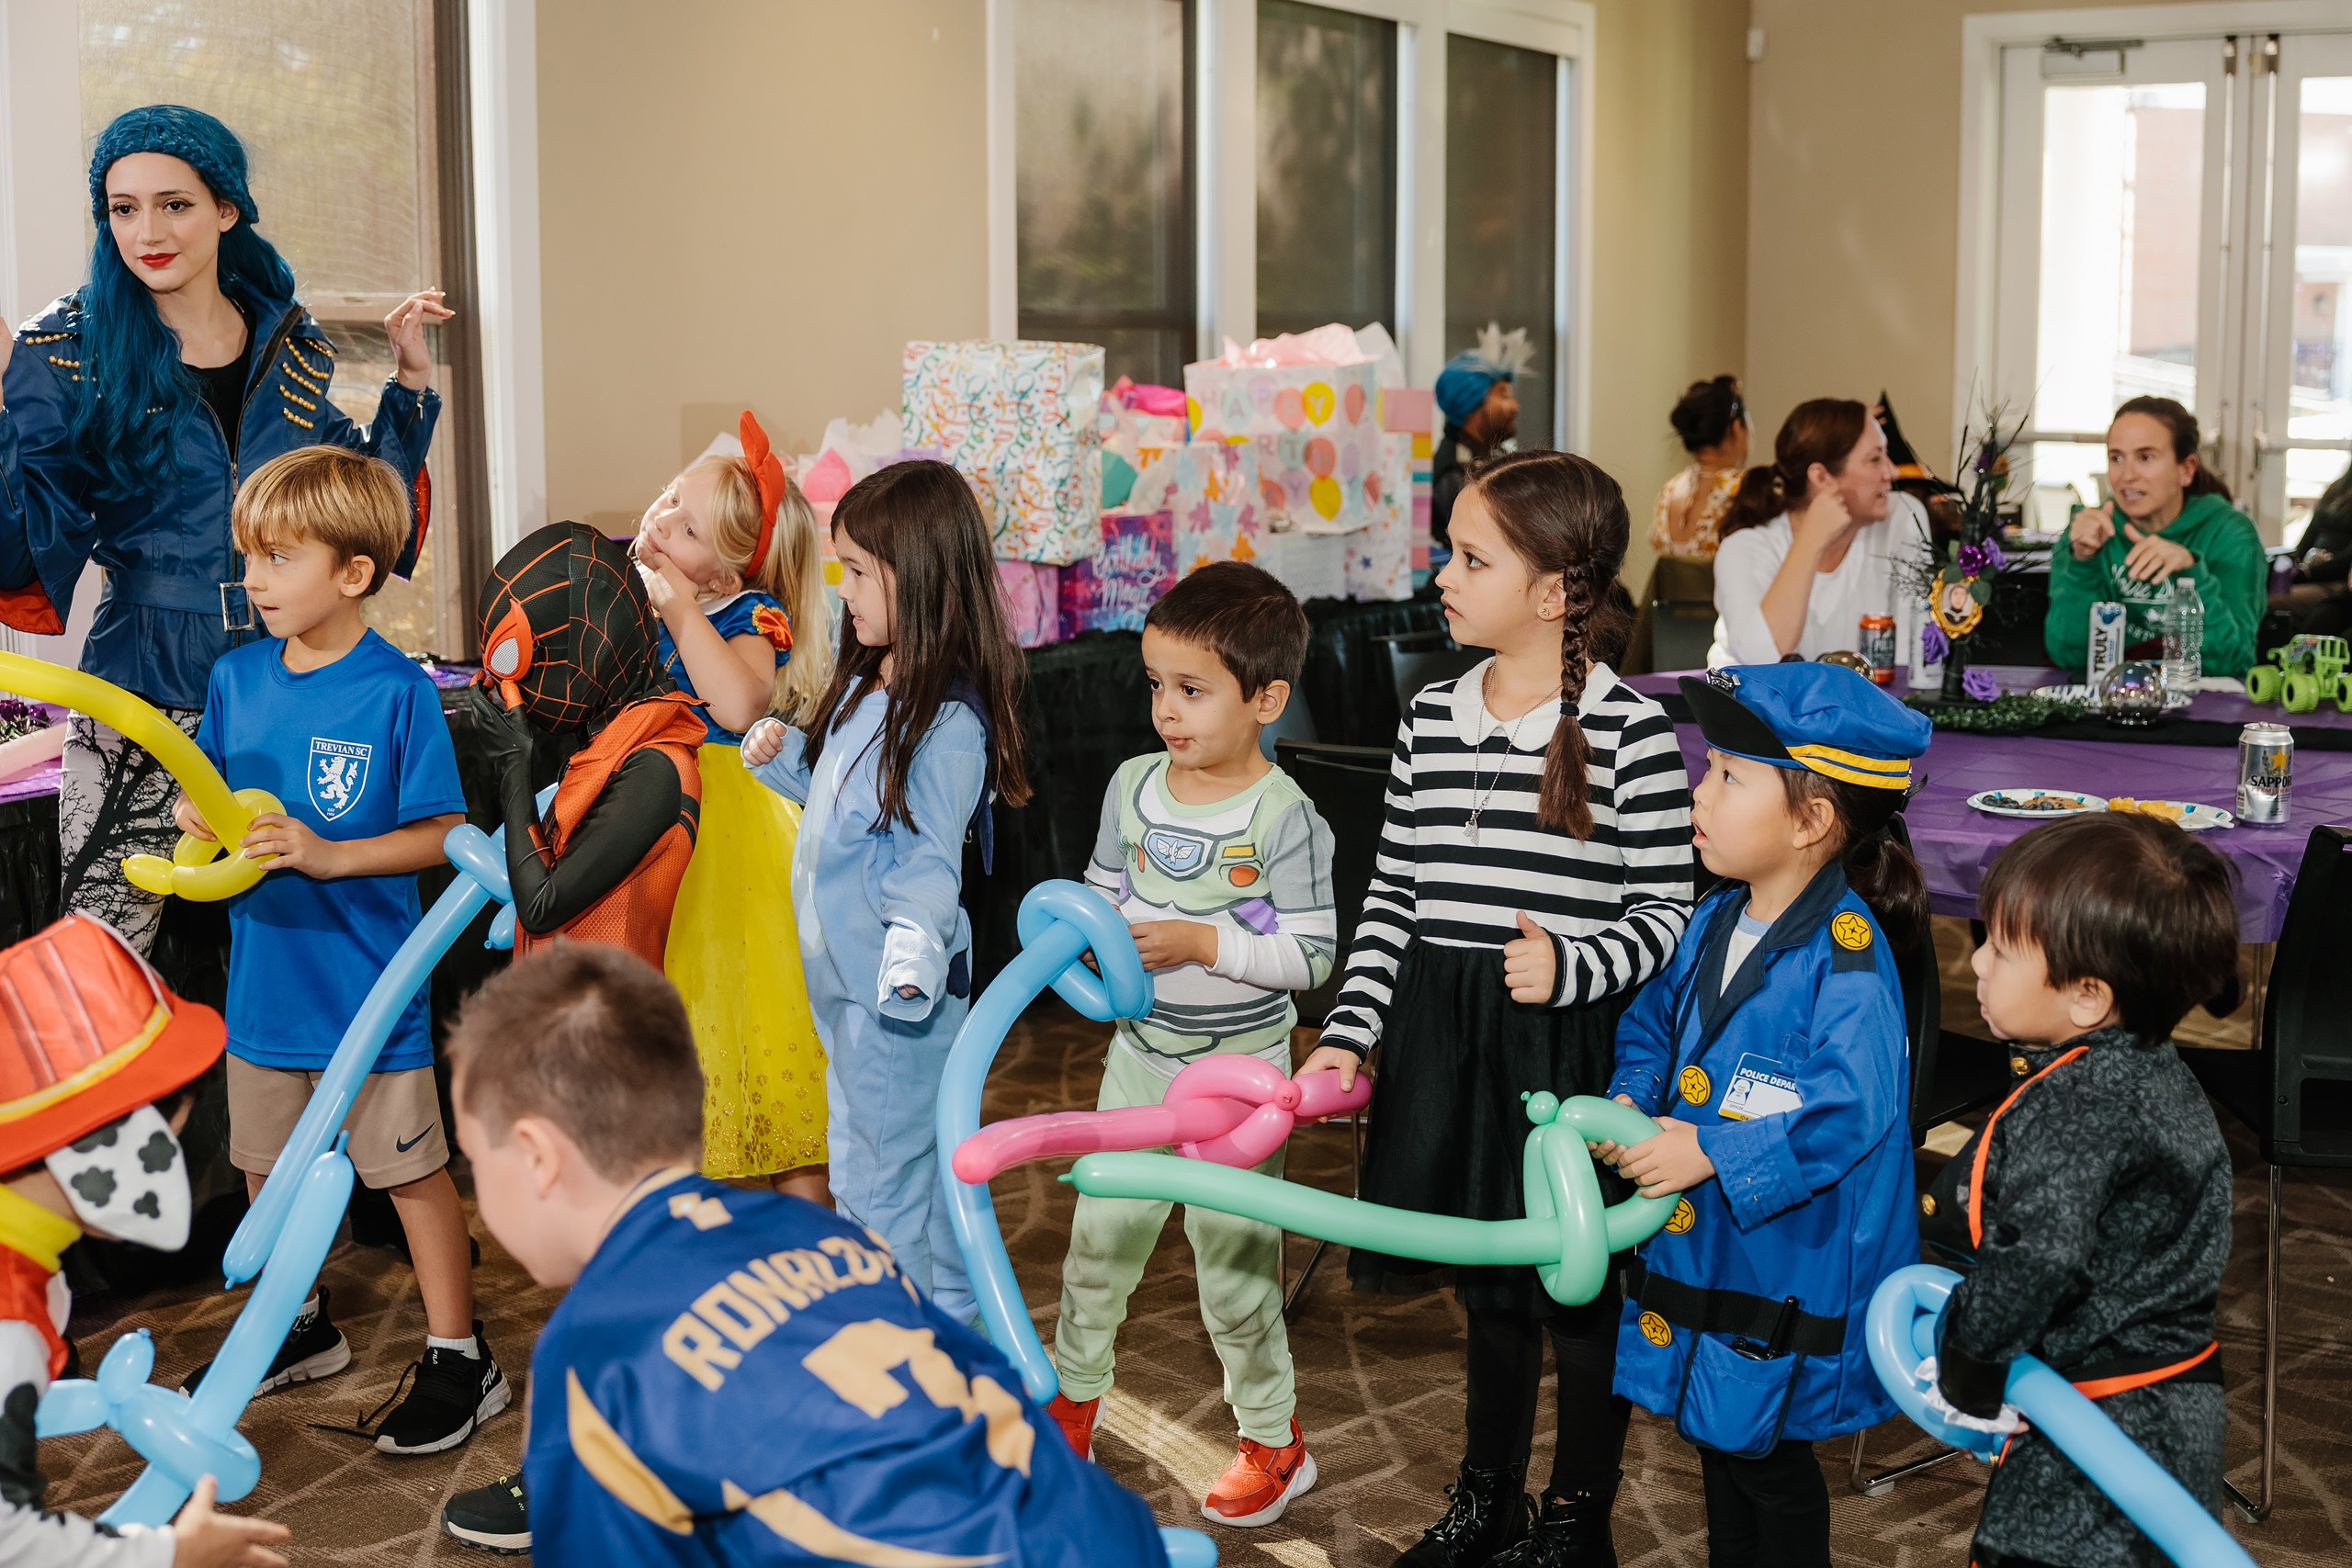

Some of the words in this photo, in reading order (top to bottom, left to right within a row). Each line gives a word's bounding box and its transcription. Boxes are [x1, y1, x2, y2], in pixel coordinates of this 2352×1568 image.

[2094, 627, 2108, 673] TRULY
[315, 741, 355, 755] TREVIAN
[356, 747, 368, 756] SC
[1740, 1067, 1770, 1082] POLICE
[481, 1359, 498, 1395] FILA
